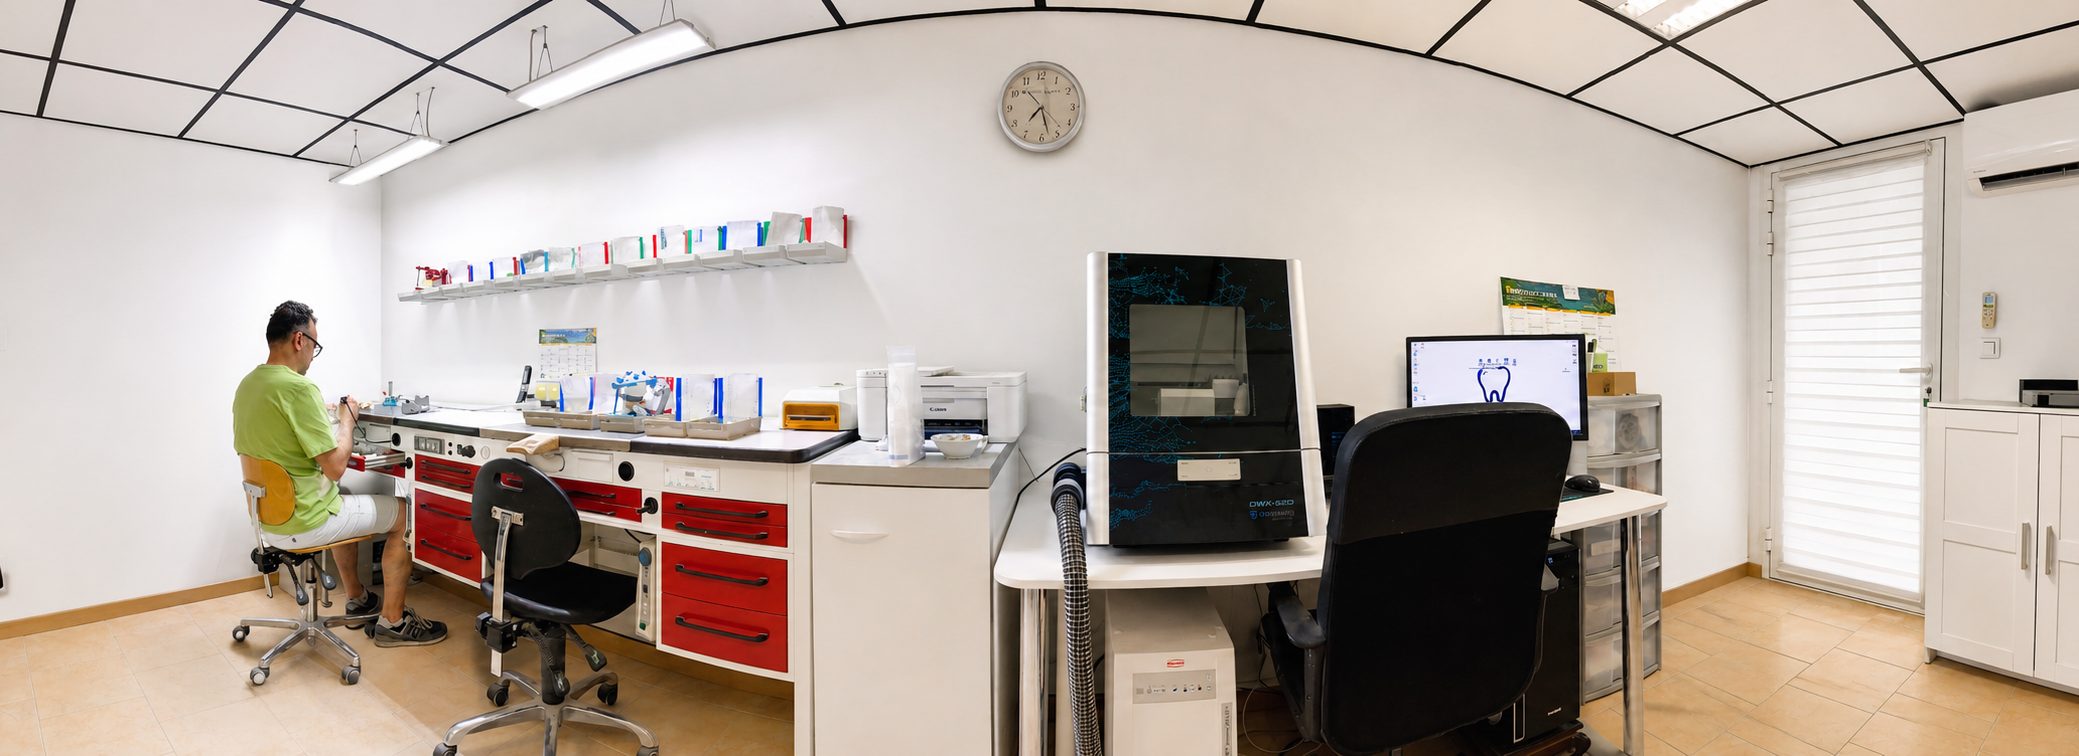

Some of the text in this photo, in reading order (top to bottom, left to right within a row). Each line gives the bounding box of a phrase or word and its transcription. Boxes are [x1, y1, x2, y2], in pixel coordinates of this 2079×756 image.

[1037, 71, 1046, 80] 12
[1023, 77, 1030, 85] 11
[1065, 87, 1071, 95] 2
[1070, 103, 1076, 111] 3
[1011, 119, 1018, 127] 8
[1023, 130, 1028, 138] 7
[1039, 133, 1045, 142] 6
[1055, 130, 1060, 138] 5
